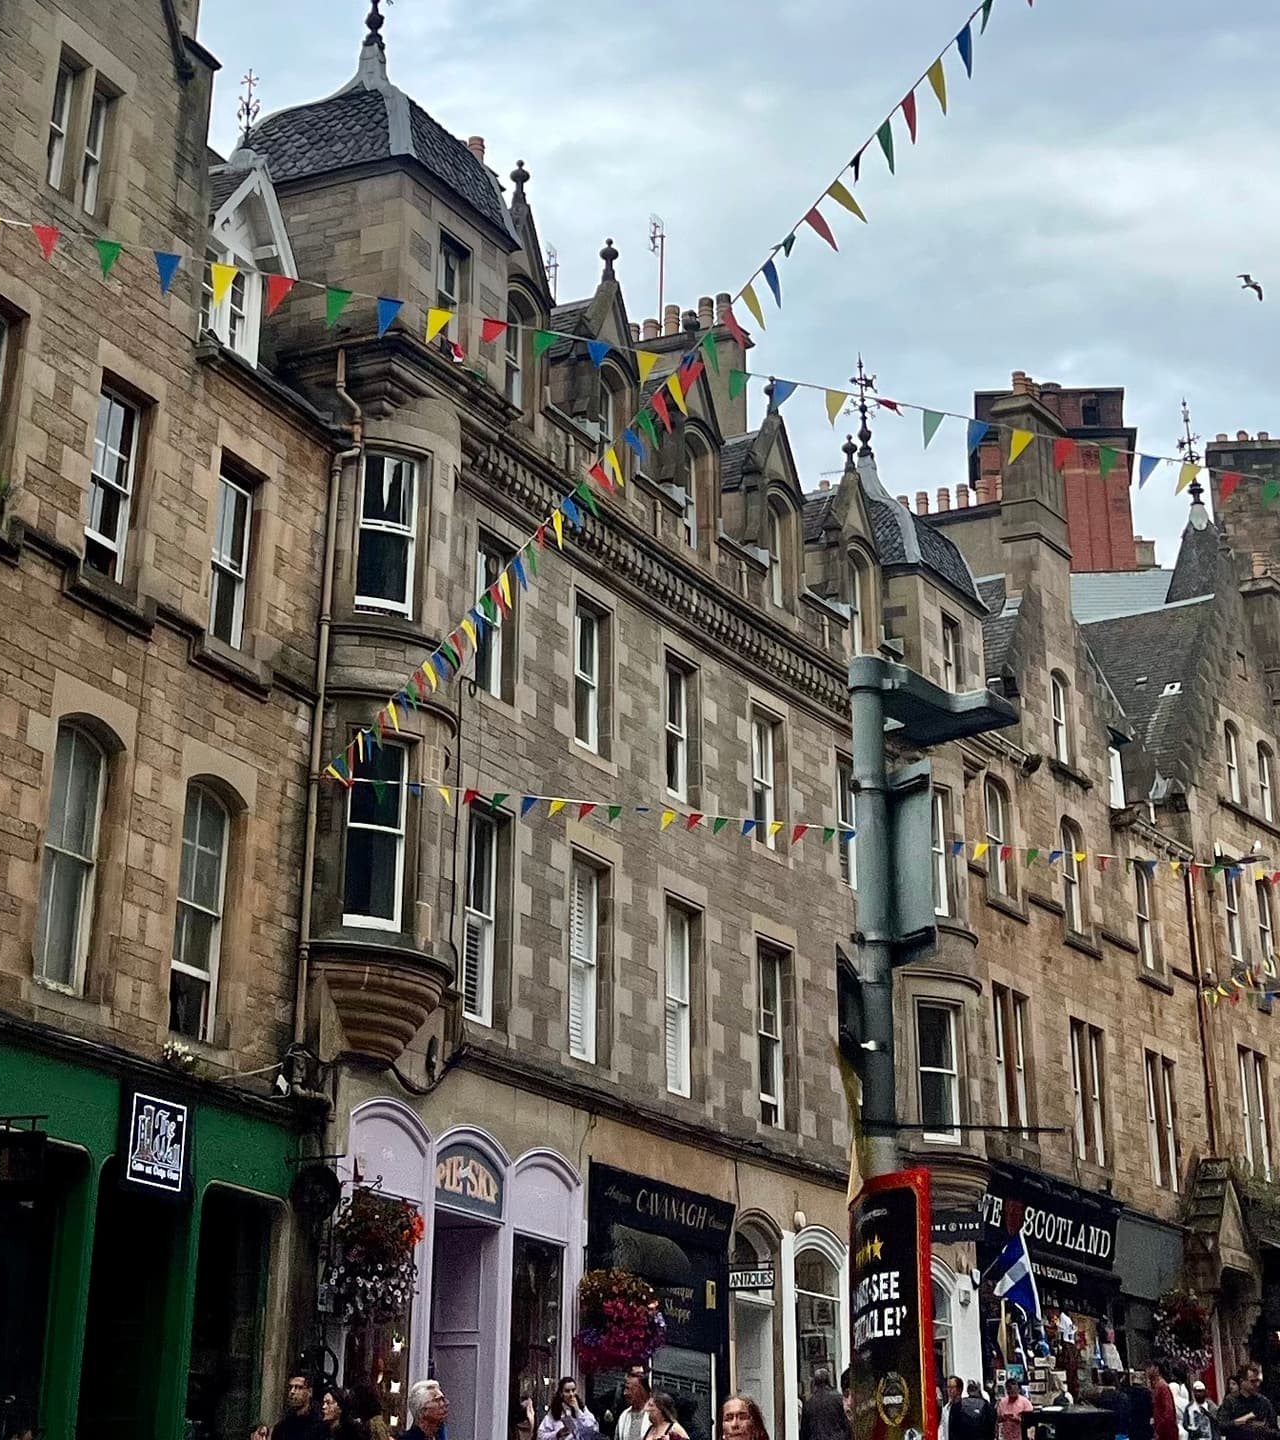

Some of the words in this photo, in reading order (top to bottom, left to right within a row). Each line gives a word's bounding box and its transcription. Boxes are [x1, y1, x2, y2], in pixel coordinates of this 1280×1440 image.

[635, 1188, 708, 1231] CAVANAGH
[977, 1193, 1004, 1228] WE
[1023, 1205, 1111, 1259] SCOTLAND
[730, 1270, 774, 1287] ANTIQUES
